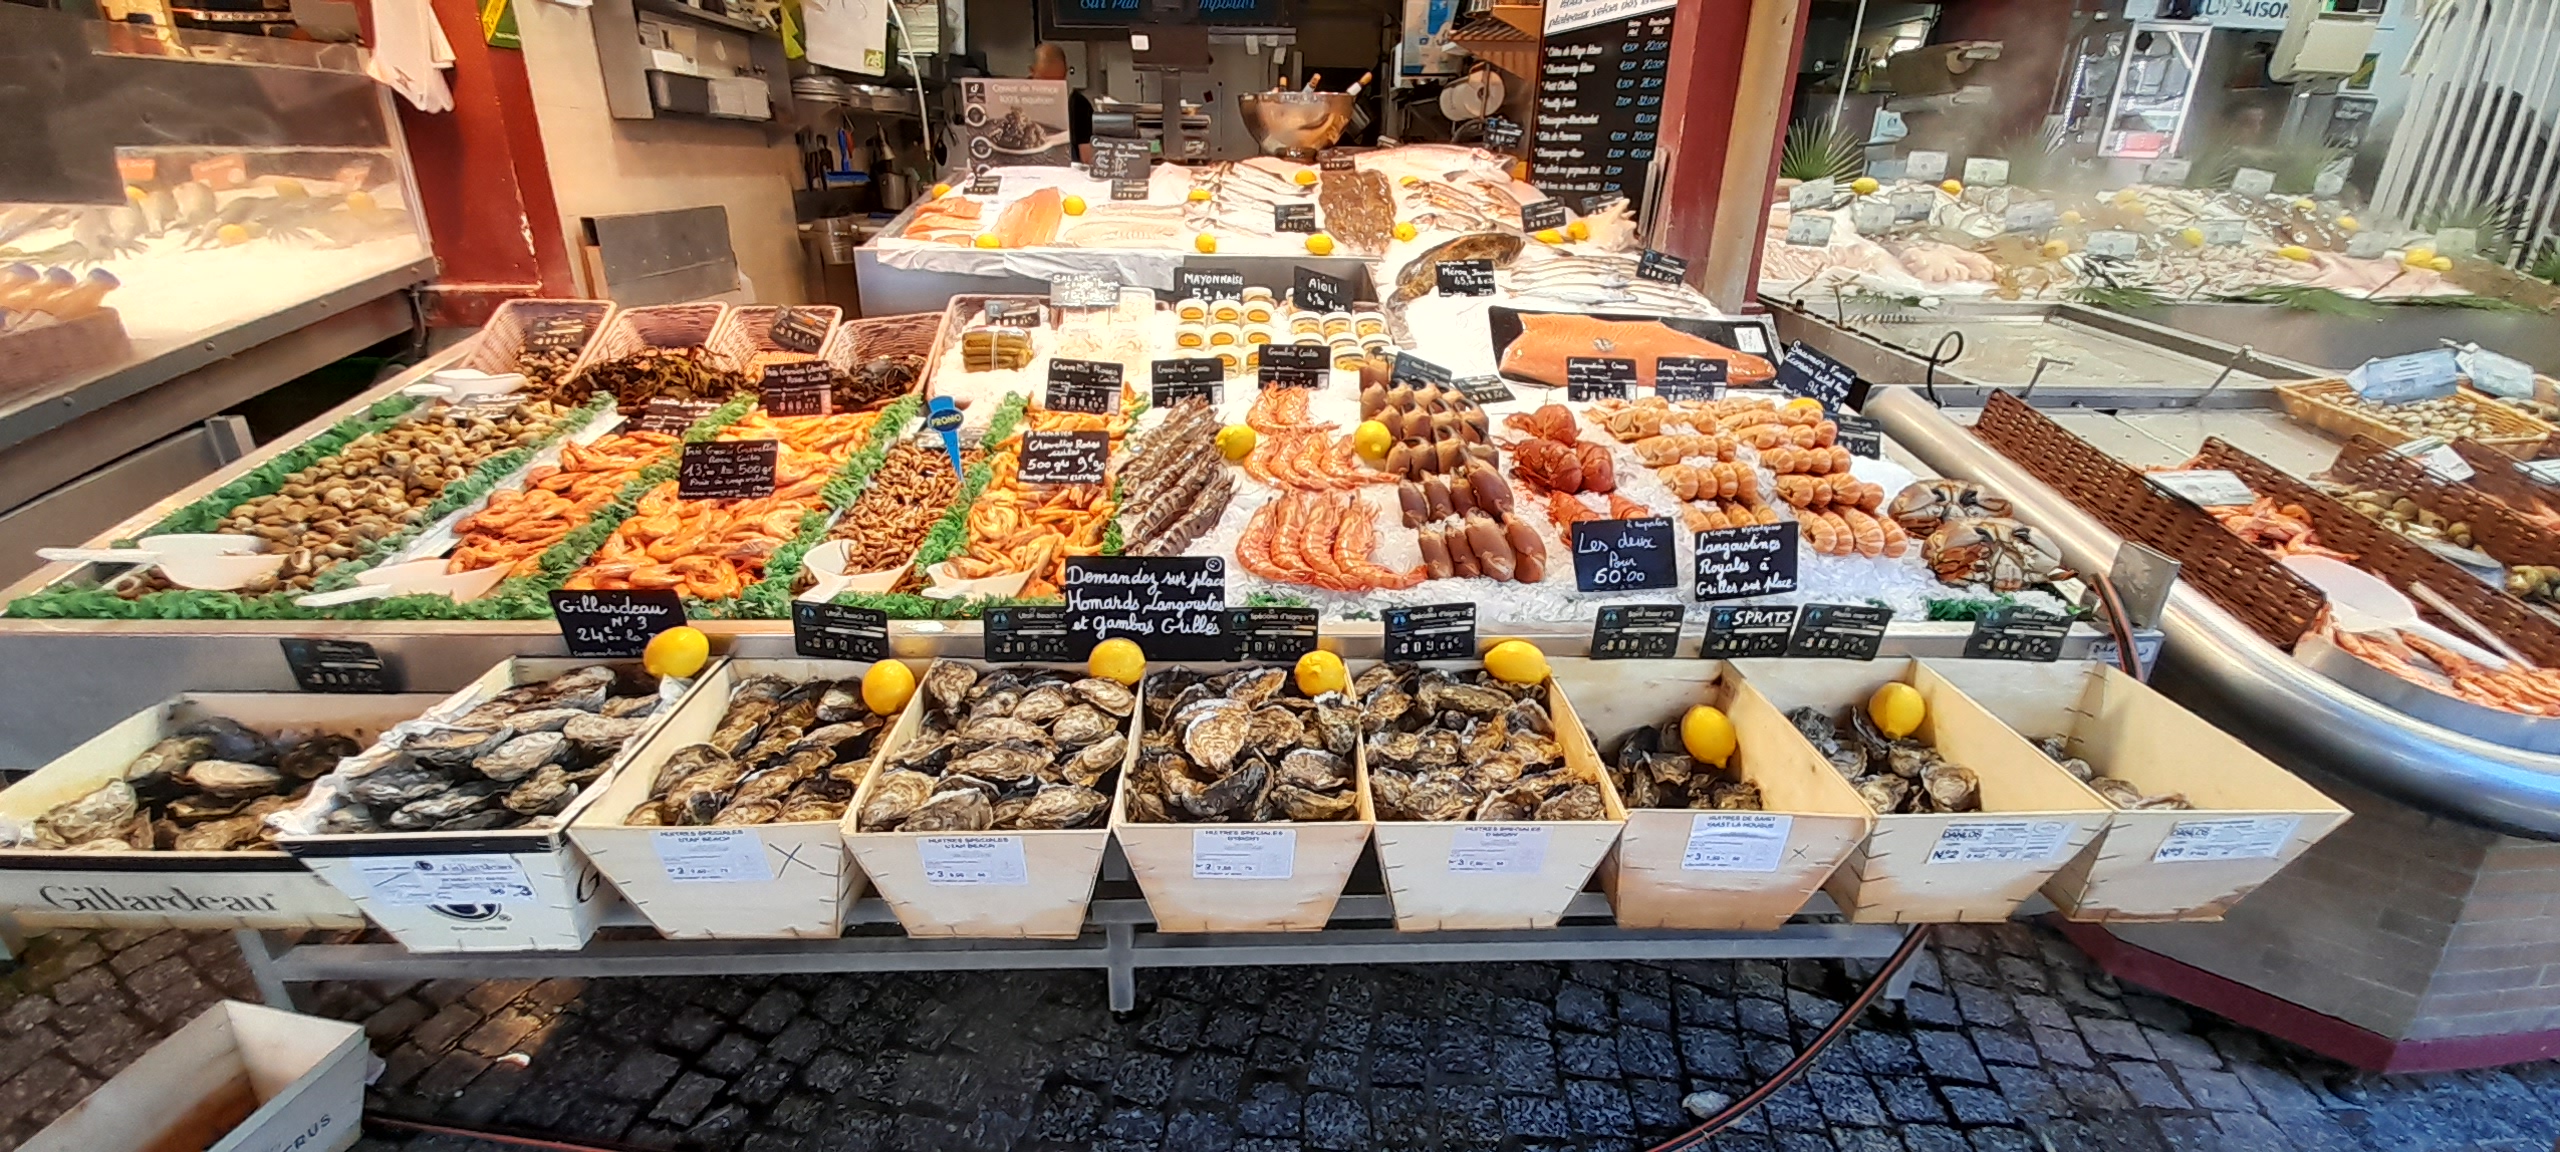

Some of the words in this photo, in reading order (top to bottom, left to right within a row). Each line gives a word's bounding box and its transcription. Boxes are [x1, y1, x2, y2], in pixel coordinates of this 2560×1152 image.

[1027, 458, 1052, 470] 500
[1578, 532, 1608, 554] Les
[1618, 532, 1657, 549] deux
[1610, 551, 1637, 568] Pour
[1700, 558, 1750, 579] Royales
[1066, 565, 1159, 595] Demandez
[1162, 571, 1187, 586] sur
[559, 594, 669, 615] Gillardeau
[1066, 588, 1140, 612] Homards
[1142, 591, 1225, 618] Langoustes
[637, 616, 647, 630] 3
[1072, 615, 1089, 631] et
[1731, 611, 1793, 626] SPRATS
[39, 886, 280, 911] Gillardeau
